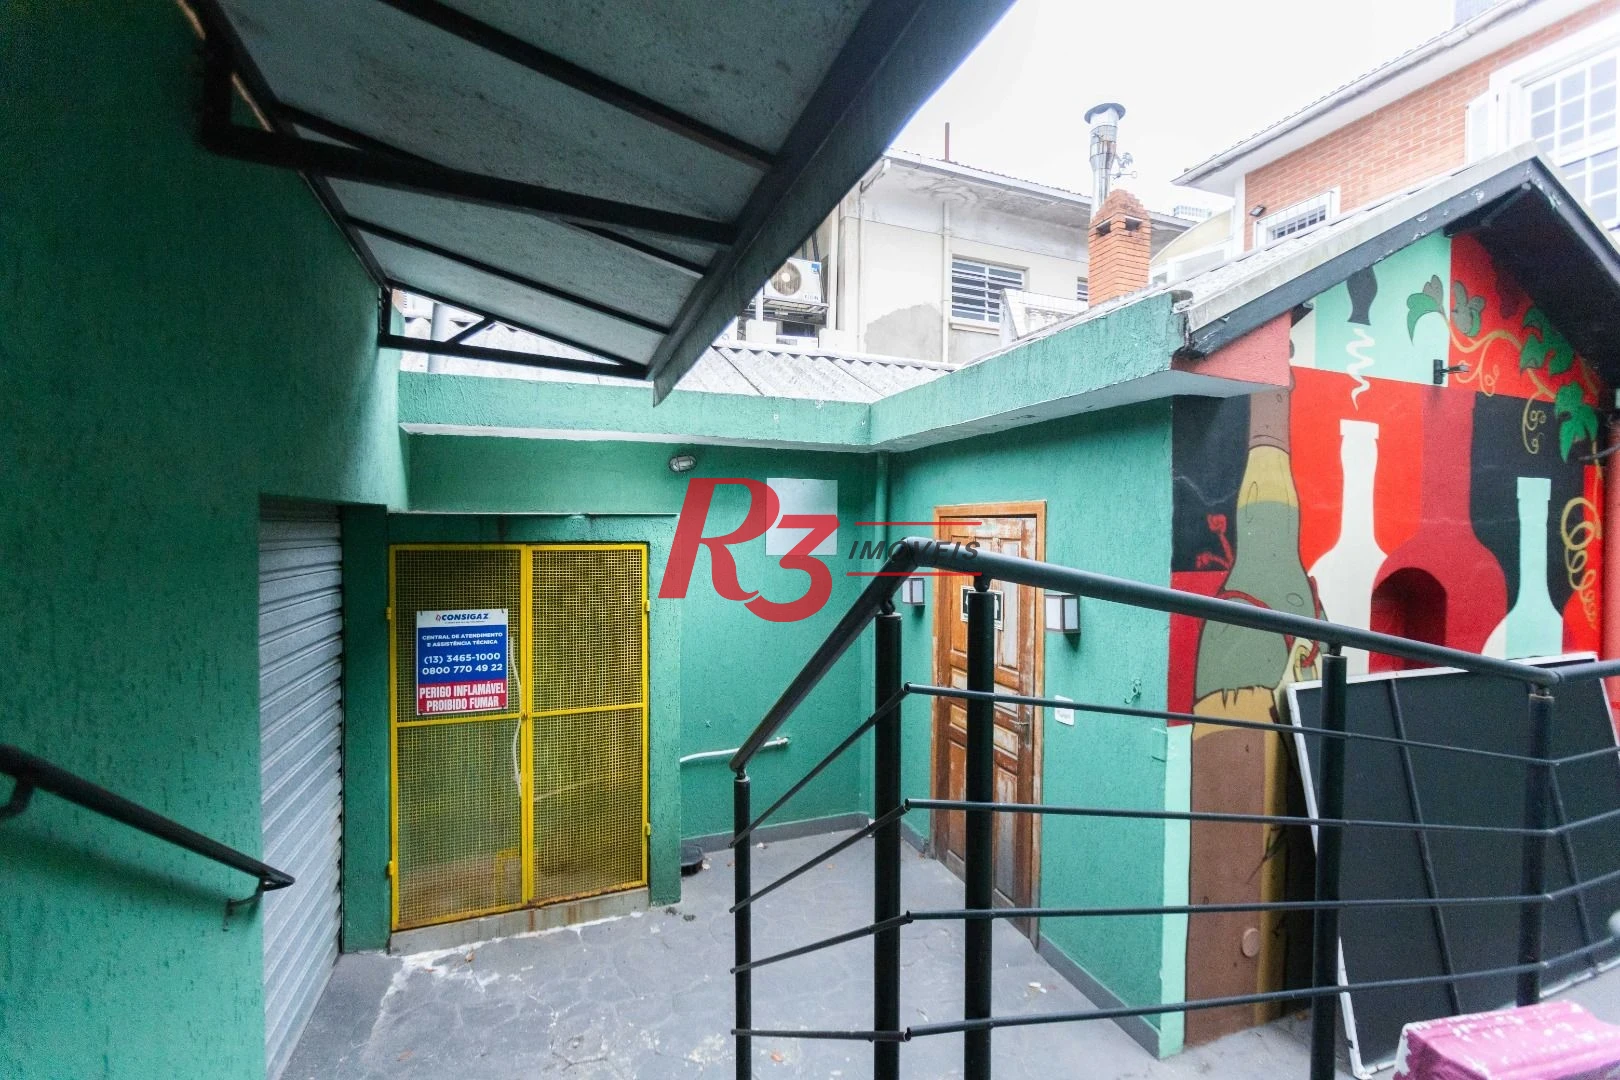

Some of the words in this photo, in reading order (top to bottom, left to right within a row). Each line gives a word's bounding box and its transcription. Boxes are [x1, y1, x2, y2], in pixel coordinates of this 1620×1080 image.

[424, 655, 443, 664] (13)
[446, 653, 500, 662] 3465-1000
[422, 666, 450, 675] 0800
[453, 665, 472, 674] 770
[475, 664, 488, 672] 49
[491, 663, 503, 671] 22
[420, 686, 451, 698] PERIGO
[453, 681, 505, 696] INFLAMÁVEL
[427, 699, 467, 711] PROIBIDO
[469, 696, 499, 709] FUMAR
